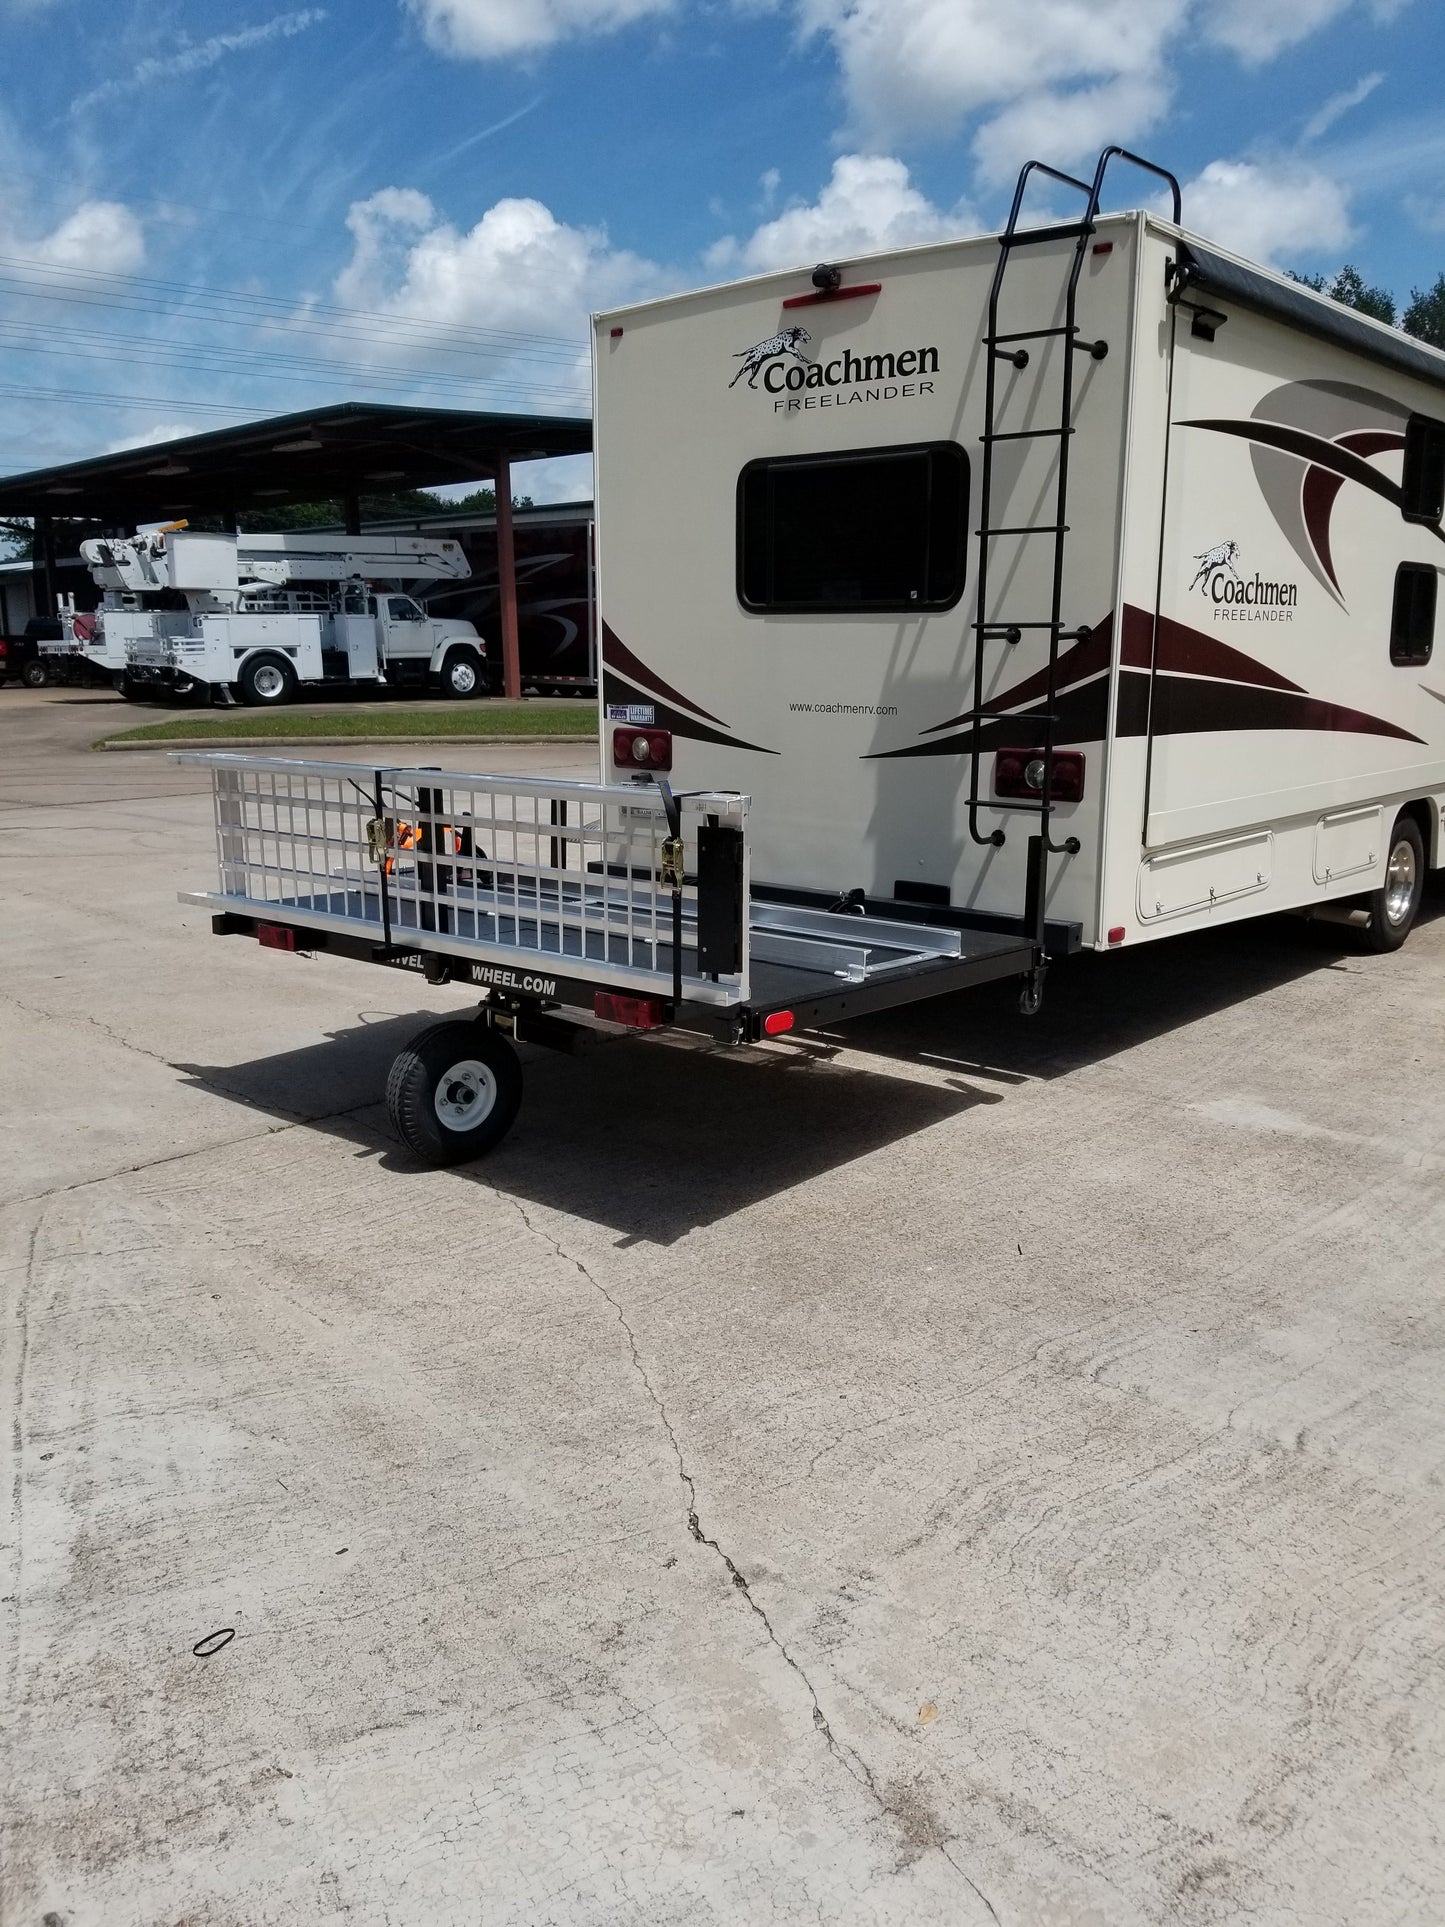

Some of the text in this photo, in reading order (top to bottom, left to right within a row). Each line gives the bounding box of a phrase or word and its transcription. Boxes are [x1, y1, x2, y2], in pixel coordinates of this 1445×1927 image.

[764, 346, 940, 393] Coachmen
[774, 381, 935, 413] FREELANDER
[1211, 572, 1297, 606] Coachmen
[1213, 608, 1293, 621] FREELANDER
[789, 703, 898, 715] www.coachmenrv.com
[472, 965, 556, 996] WHEEL.COM
